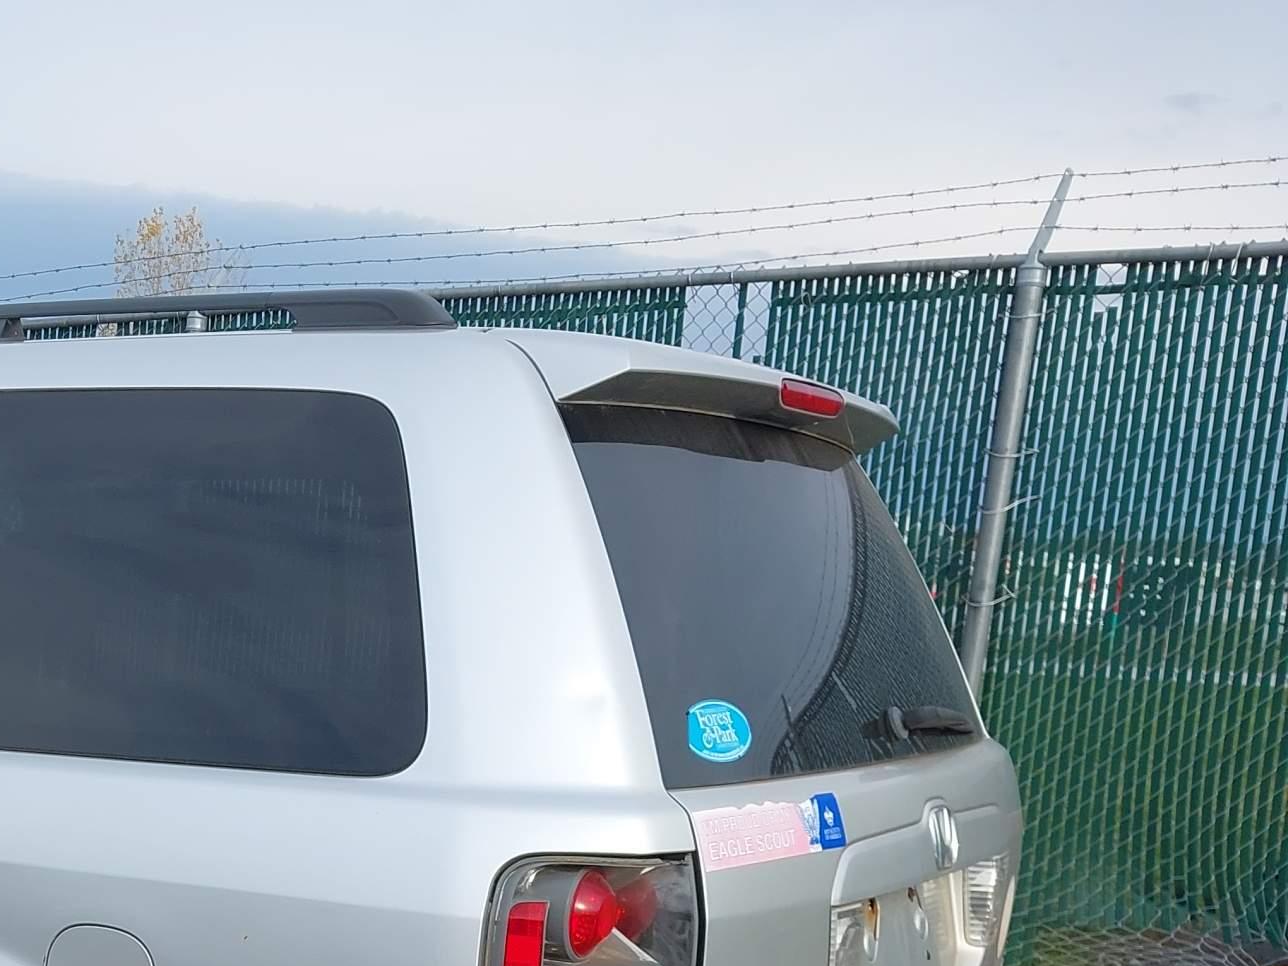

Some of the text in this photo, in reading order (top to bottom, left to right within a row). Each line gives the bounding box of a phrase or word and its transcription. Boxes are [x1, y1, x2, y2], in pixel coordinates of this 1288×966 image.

[696, 710, 733, 728] Forest
[712, 724, 739, 744] Park
[709, 837, 755, 860] EAGLE
[757, 830, 795, 852] SCOUT
